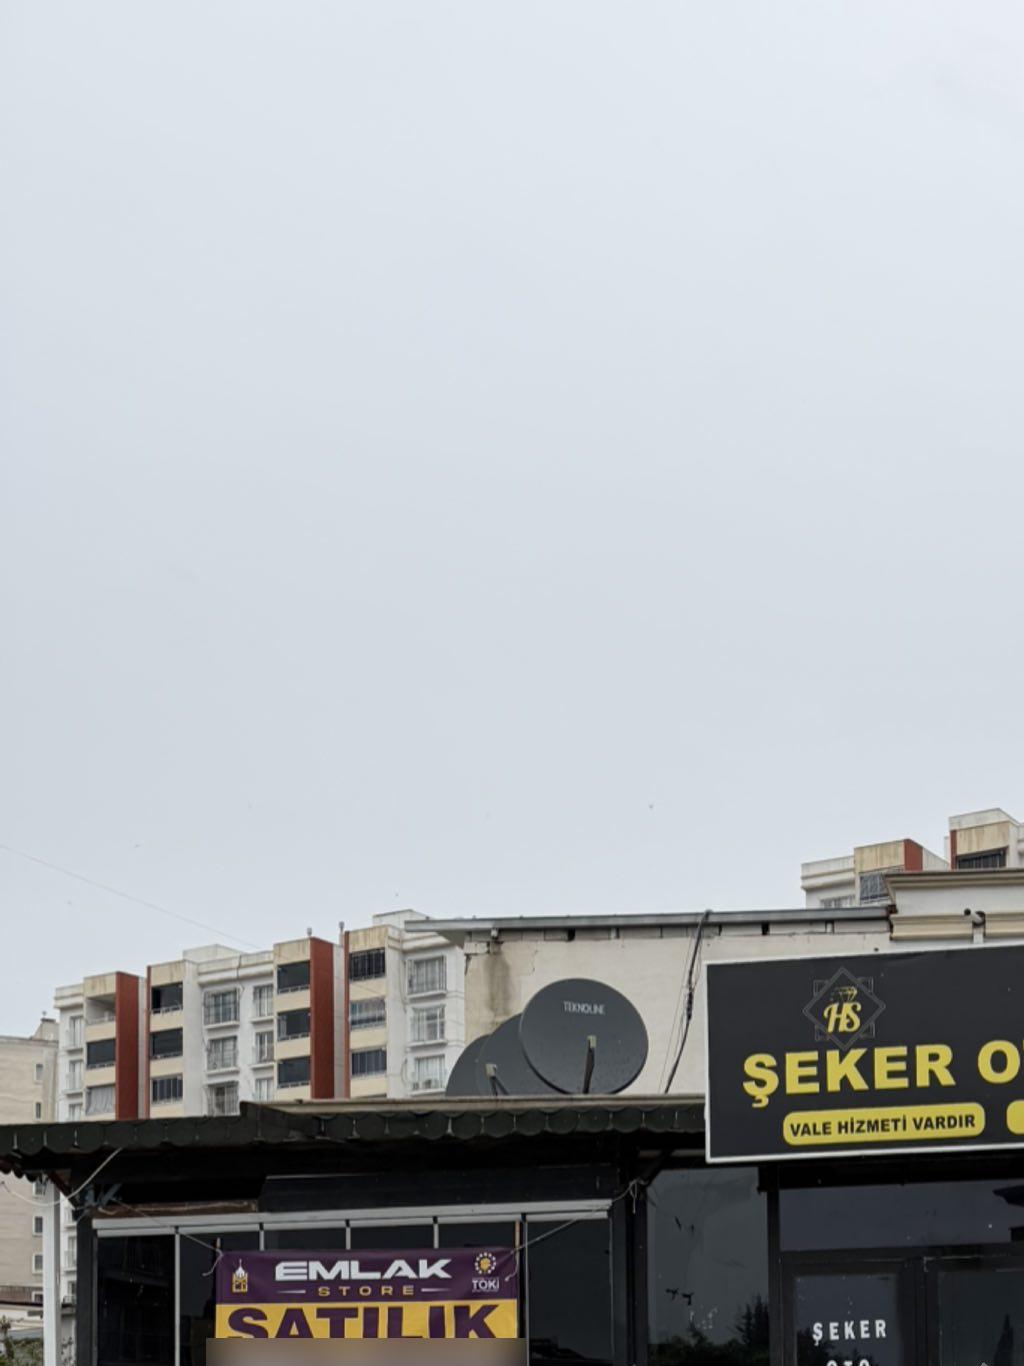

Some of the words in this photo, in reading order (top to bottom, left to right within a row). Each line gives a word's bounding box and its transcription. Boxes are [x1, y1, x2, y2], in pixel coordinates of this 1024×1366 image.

[743, 1044, 956, 1108] ŞEKER
[790, 1121, 832, 1137] VALE
[838, 1113, 907, 1134] HİZMETİ
[913, 1112, 976, 1131] VARDIR
[275, 1258, 452, 1281] EMLAK
[318, 1285, 415, 1296] STORE
[812, 1319, 888, 1346] ŞEKER
